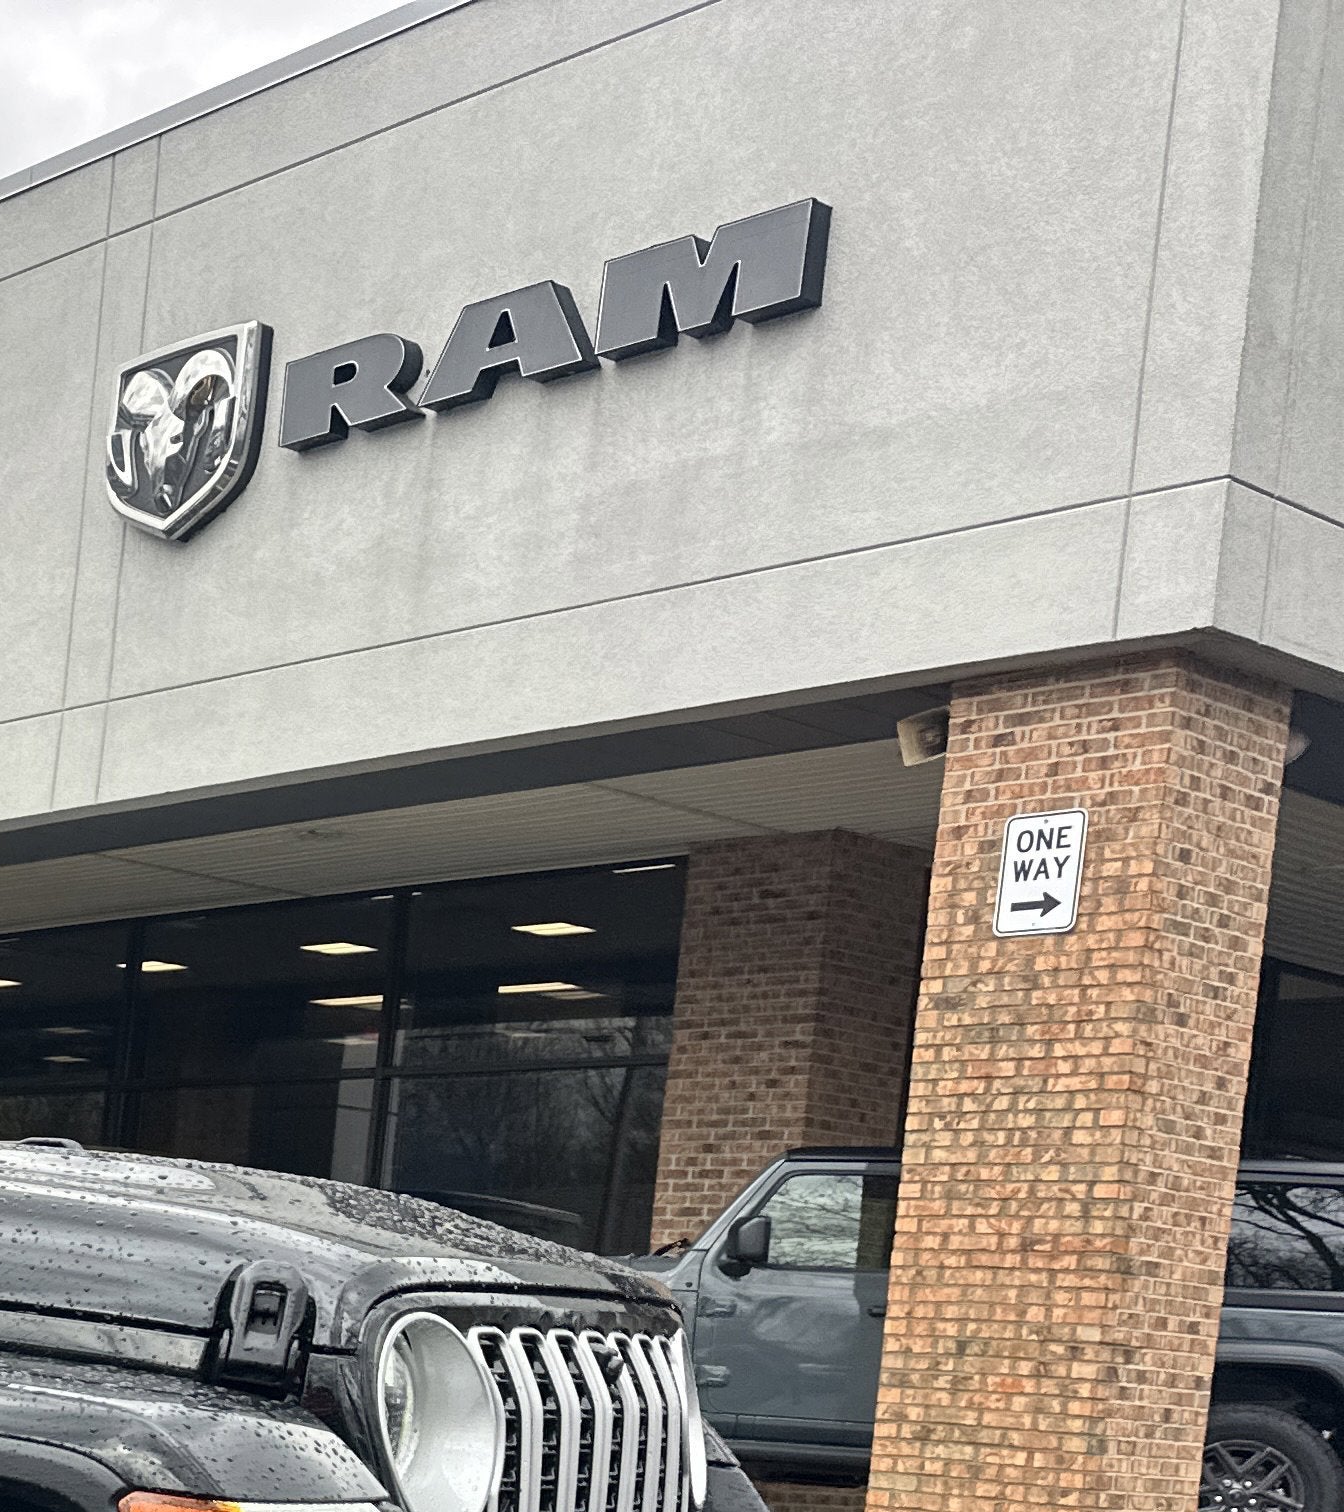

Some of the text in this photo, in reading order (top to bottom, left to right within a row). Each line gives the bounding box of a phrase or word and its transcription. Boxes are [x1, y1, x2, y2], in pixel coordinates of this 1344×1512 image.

[278, 197, 834, 452] RAM
[1016, 825, 1073, 853] ONE
[1013, 855, 1071, 883] WAY
